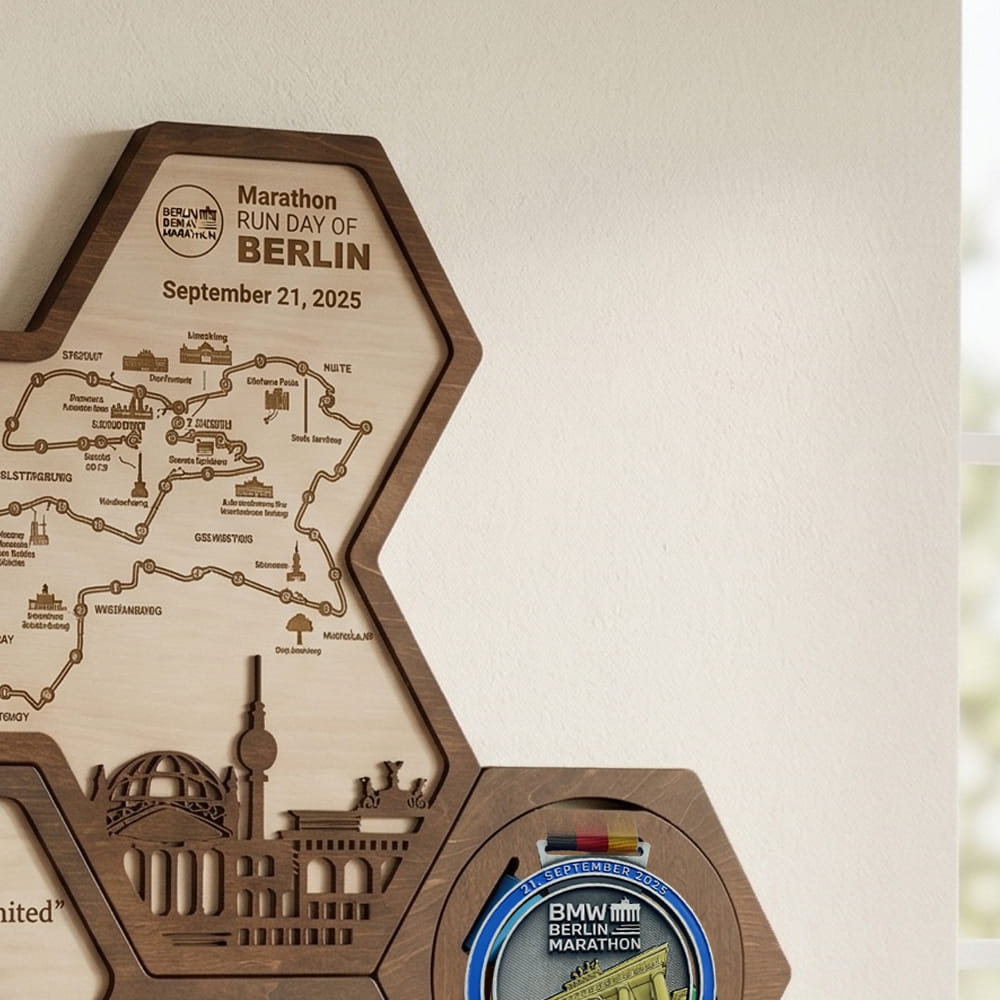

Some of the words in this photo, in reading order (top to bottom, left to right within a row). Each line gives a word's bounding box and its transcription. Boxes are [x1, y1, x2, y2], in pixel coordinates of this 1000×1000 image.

[238, 185, 337, 210] Marathon
[238, 210, 279, 231] RUN
[287, 214, 326, 234] DAY
[332, 217, 358, 235] OF
[238, 235, 370, 271] BERLIN
[162, 280, 272, 305] September
[277, 287, 307, 310] 21,
[312, 289, 362, 309] 2025
[520, 879, 542, 895] 21.
[544, 862, 631, 883] SEPTEMBER
[635, 870, 669, 896] 2025
[549, 903, 608, 922] BMW
[549, 923, 608, 936] BERLIN
[549, 937, 642, 952] MARATHON
